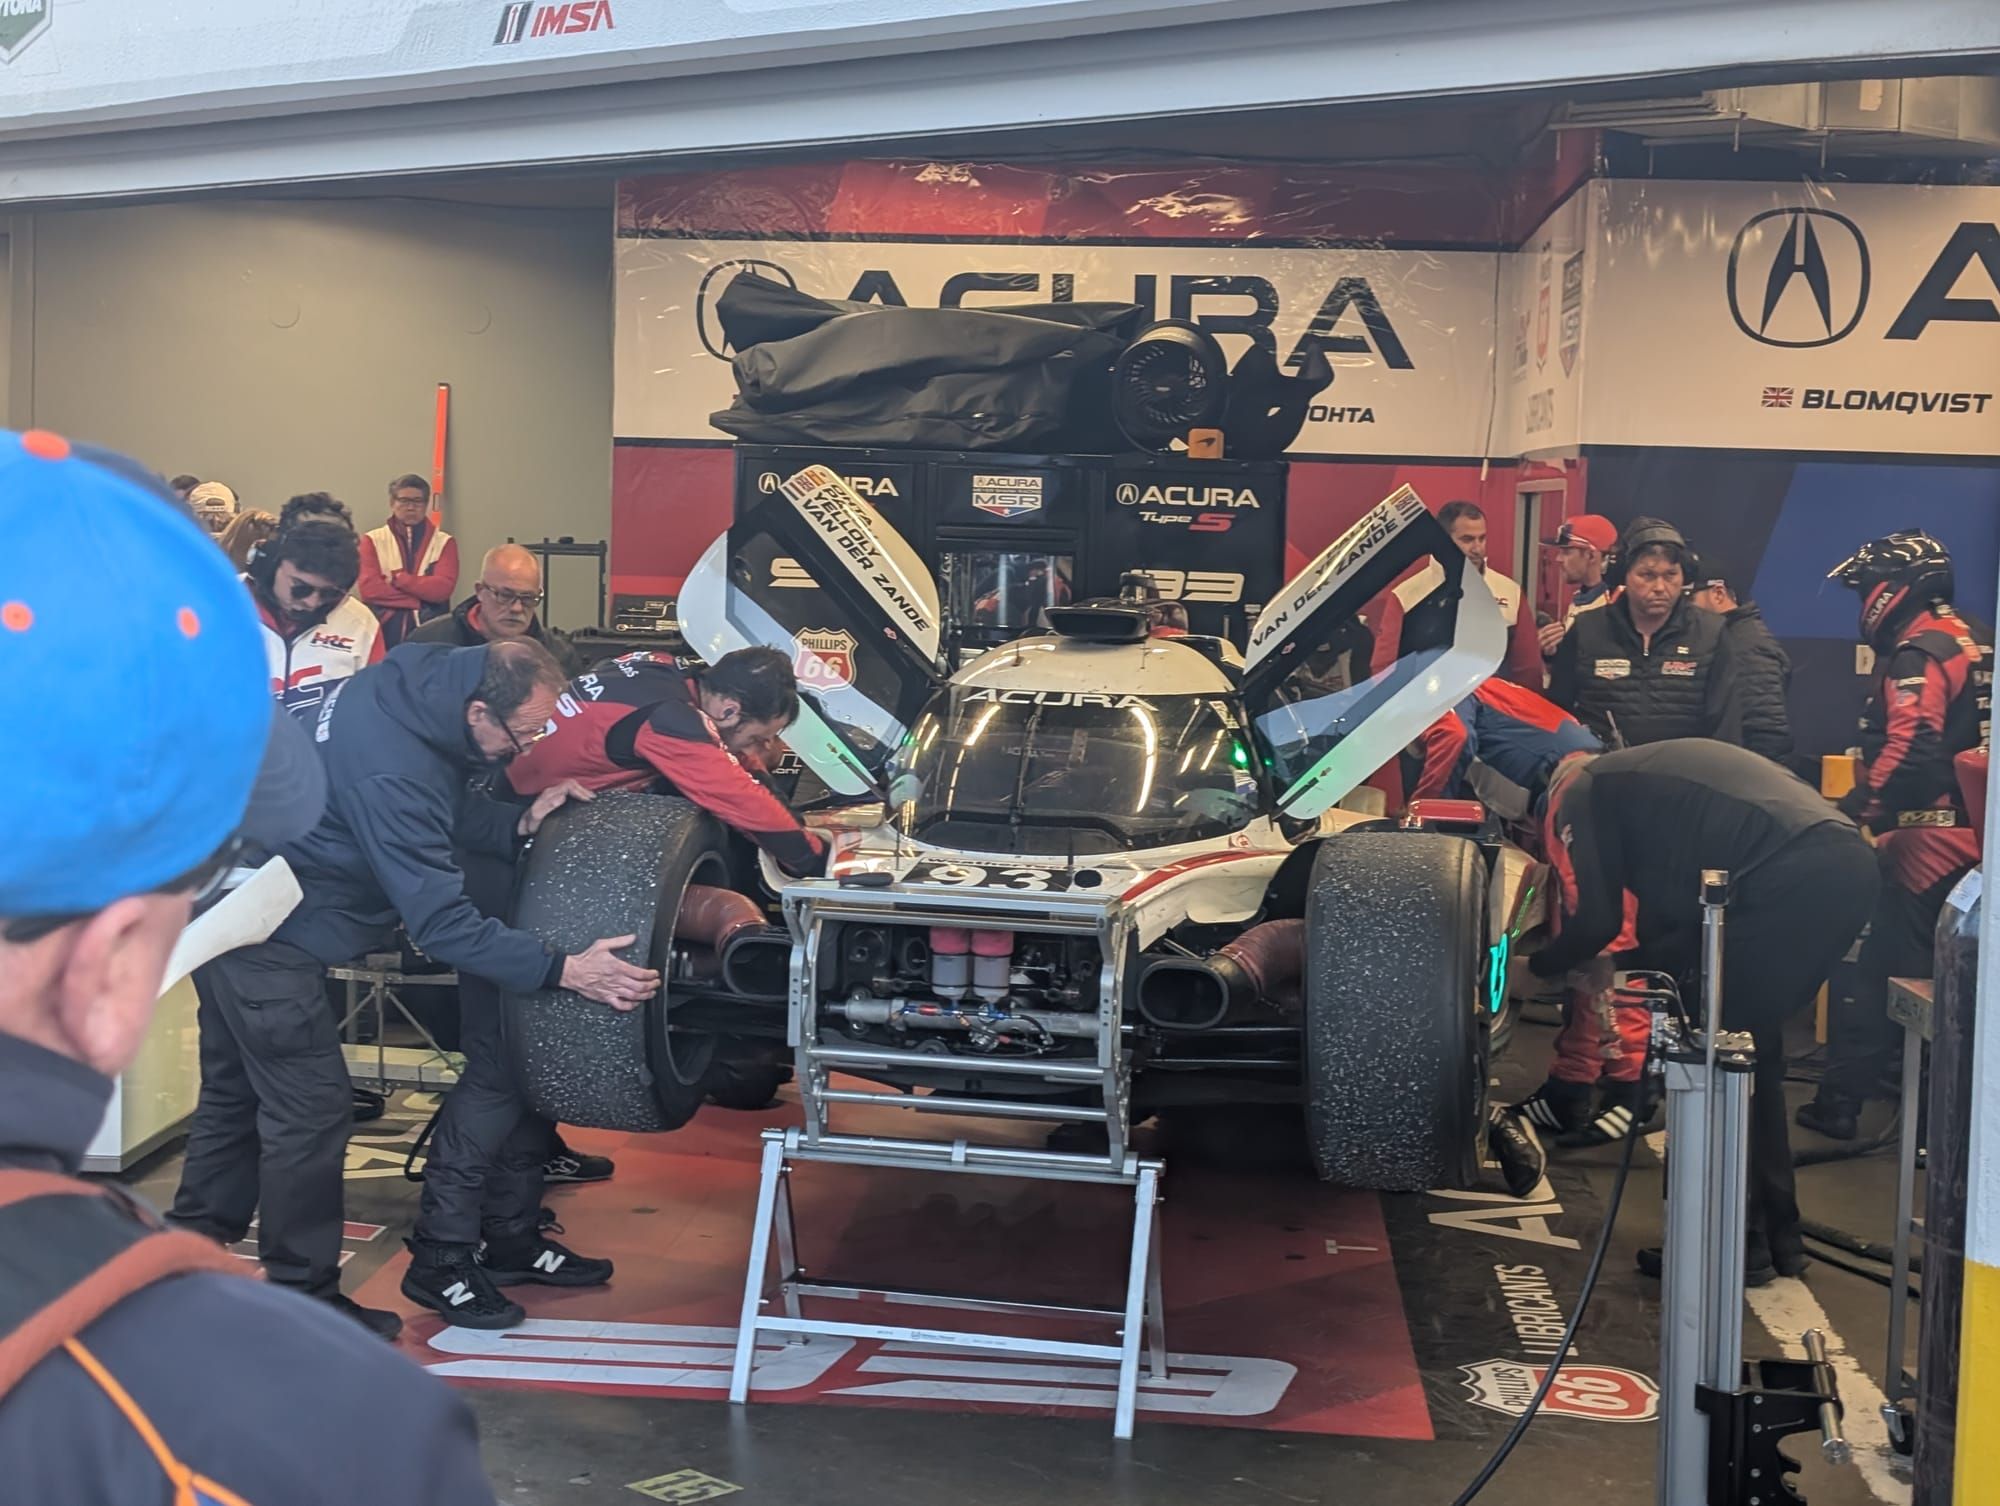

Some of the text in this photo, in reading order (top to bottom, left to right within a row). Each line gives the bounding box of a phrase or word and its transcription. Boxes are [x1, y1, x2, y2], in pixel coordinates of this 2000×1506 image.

[530, 1, 615, 37] IMSA
[1308, 405, 1375, 423] OHTA
[1802, 389, 1993, 414] BLOMQVIST
[986, 478, 1040, 487] ACURA
[975, 495, 1041, 506] MSR
[1139, 485, 1260, 508] ACURA
[814, 492, 881, 558] YELLOLY
[1139, 511, 1237, 532] Type S
[802, 498, 839, 533] VAN
[837, 536, 874, 570] DER
[872, 573, 930, 632] ZANDE
[1253, 612, 1288, 646] VAN
[1336, 518, 1398, 575] ZANDE
[801, 638, 847, 650] PHILLIPS
[804, 656, 843, 679] 66
[961, 688, 1159, 711] ACURA
[922, 865, 1053, 891] 93
[533, 1250, 566, 1273] N
[442, 1281, 475, 1306] N
[1494, 1263, 1579, 1356] LUBRICANTS
[1491, 1366, 1534, 1407] PHILLIPS
[1553, 1373, 1629, 1411] 66
